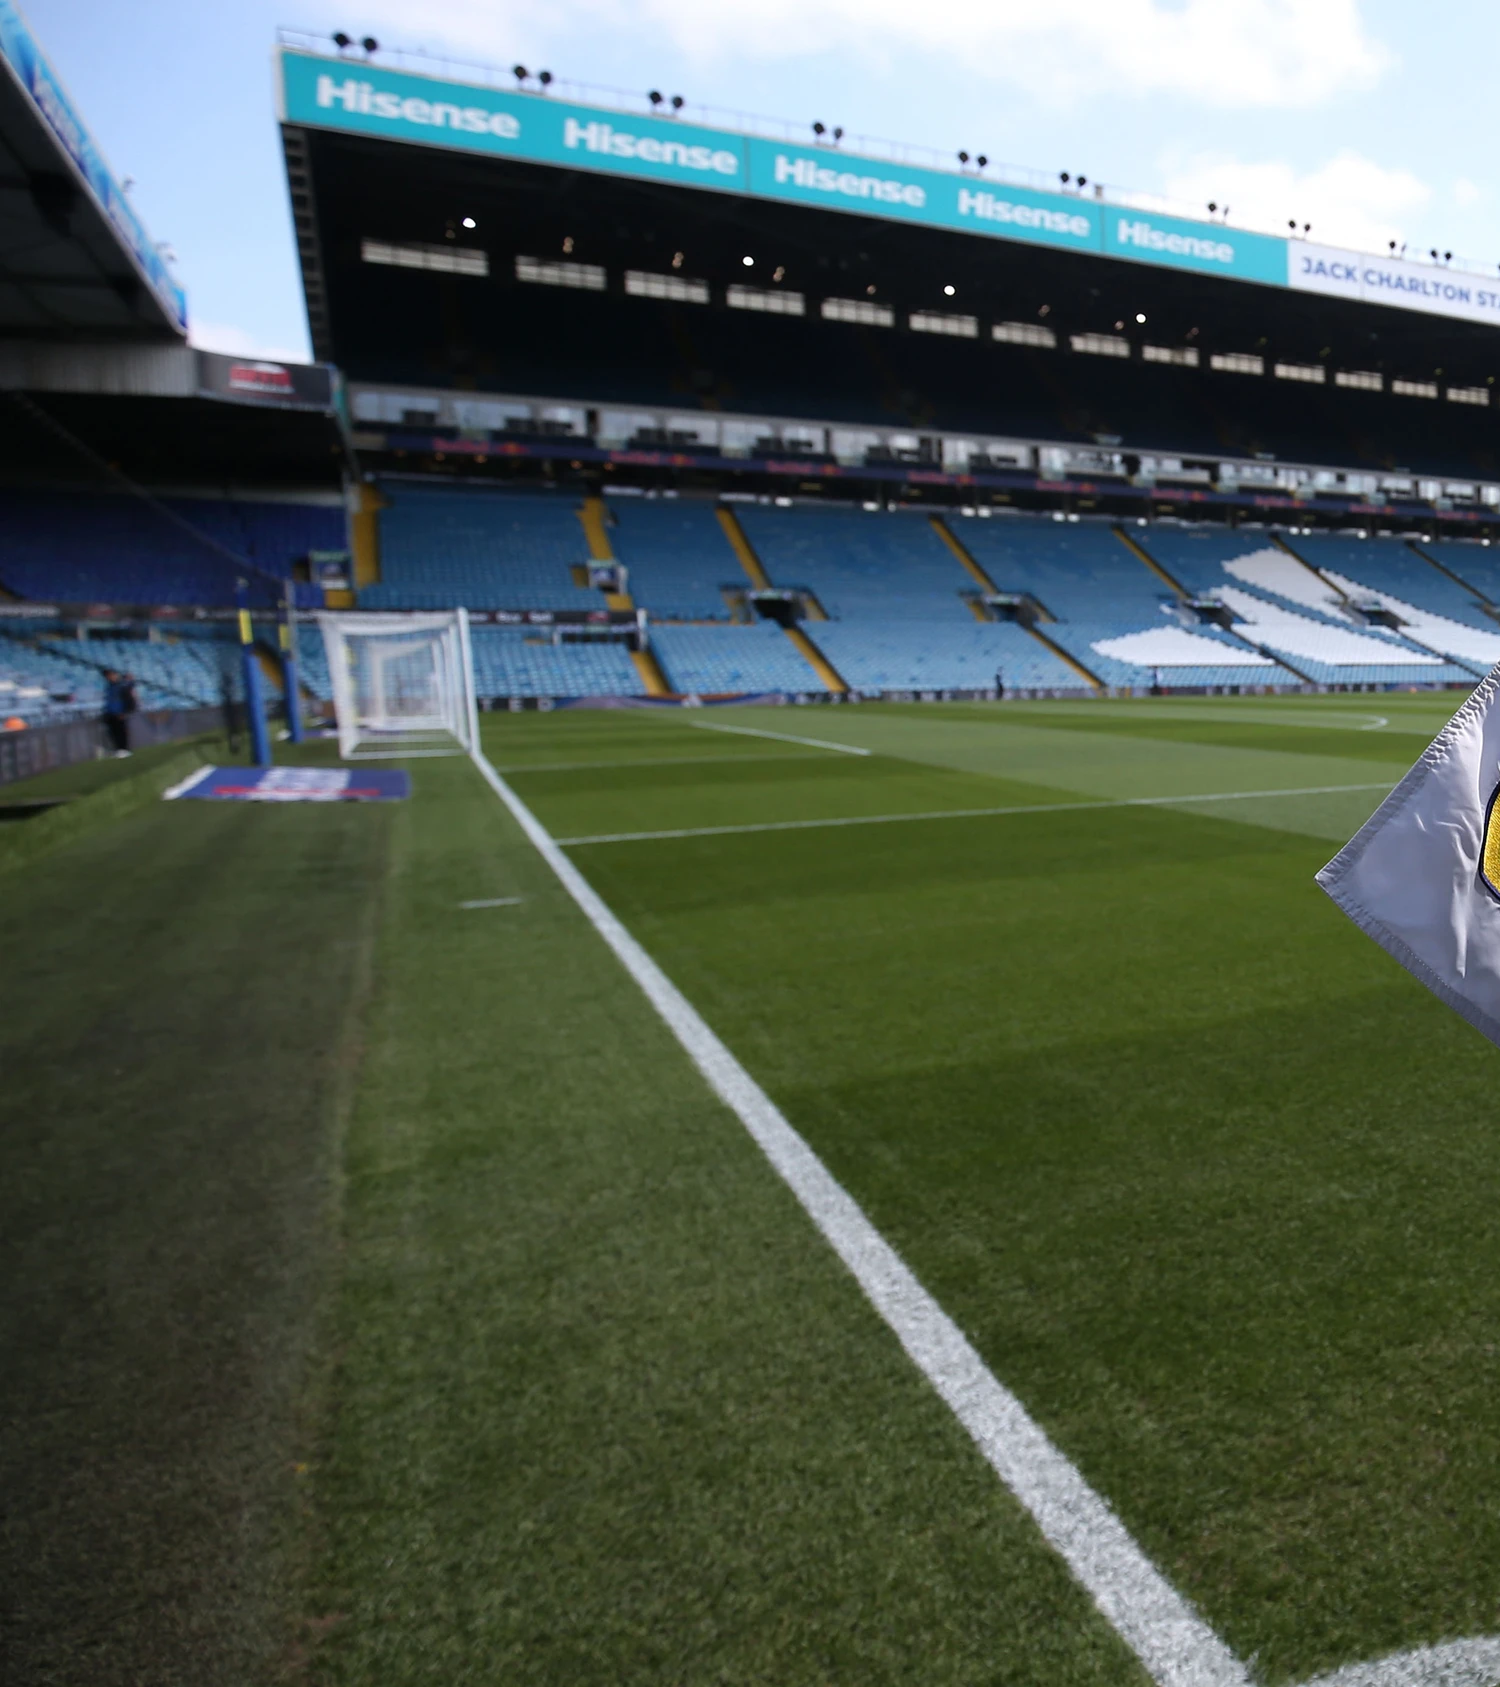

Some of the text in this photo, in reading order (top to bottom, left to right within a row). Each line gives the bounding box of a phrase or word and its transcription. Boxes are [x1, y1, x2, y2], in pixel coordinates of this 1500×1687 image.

[317, 75, 519, 138] Hisense
[564, 117, 738, 174] Hisense
[775, 155, 925, 207] Hisense
[958, 188, 1090, 237] Hisense
[1118, 219, 1234, 264] Hisense
[1301, 256, 1357, 283] JACK
[1363, 265, 1471, 305] CHARLTON
